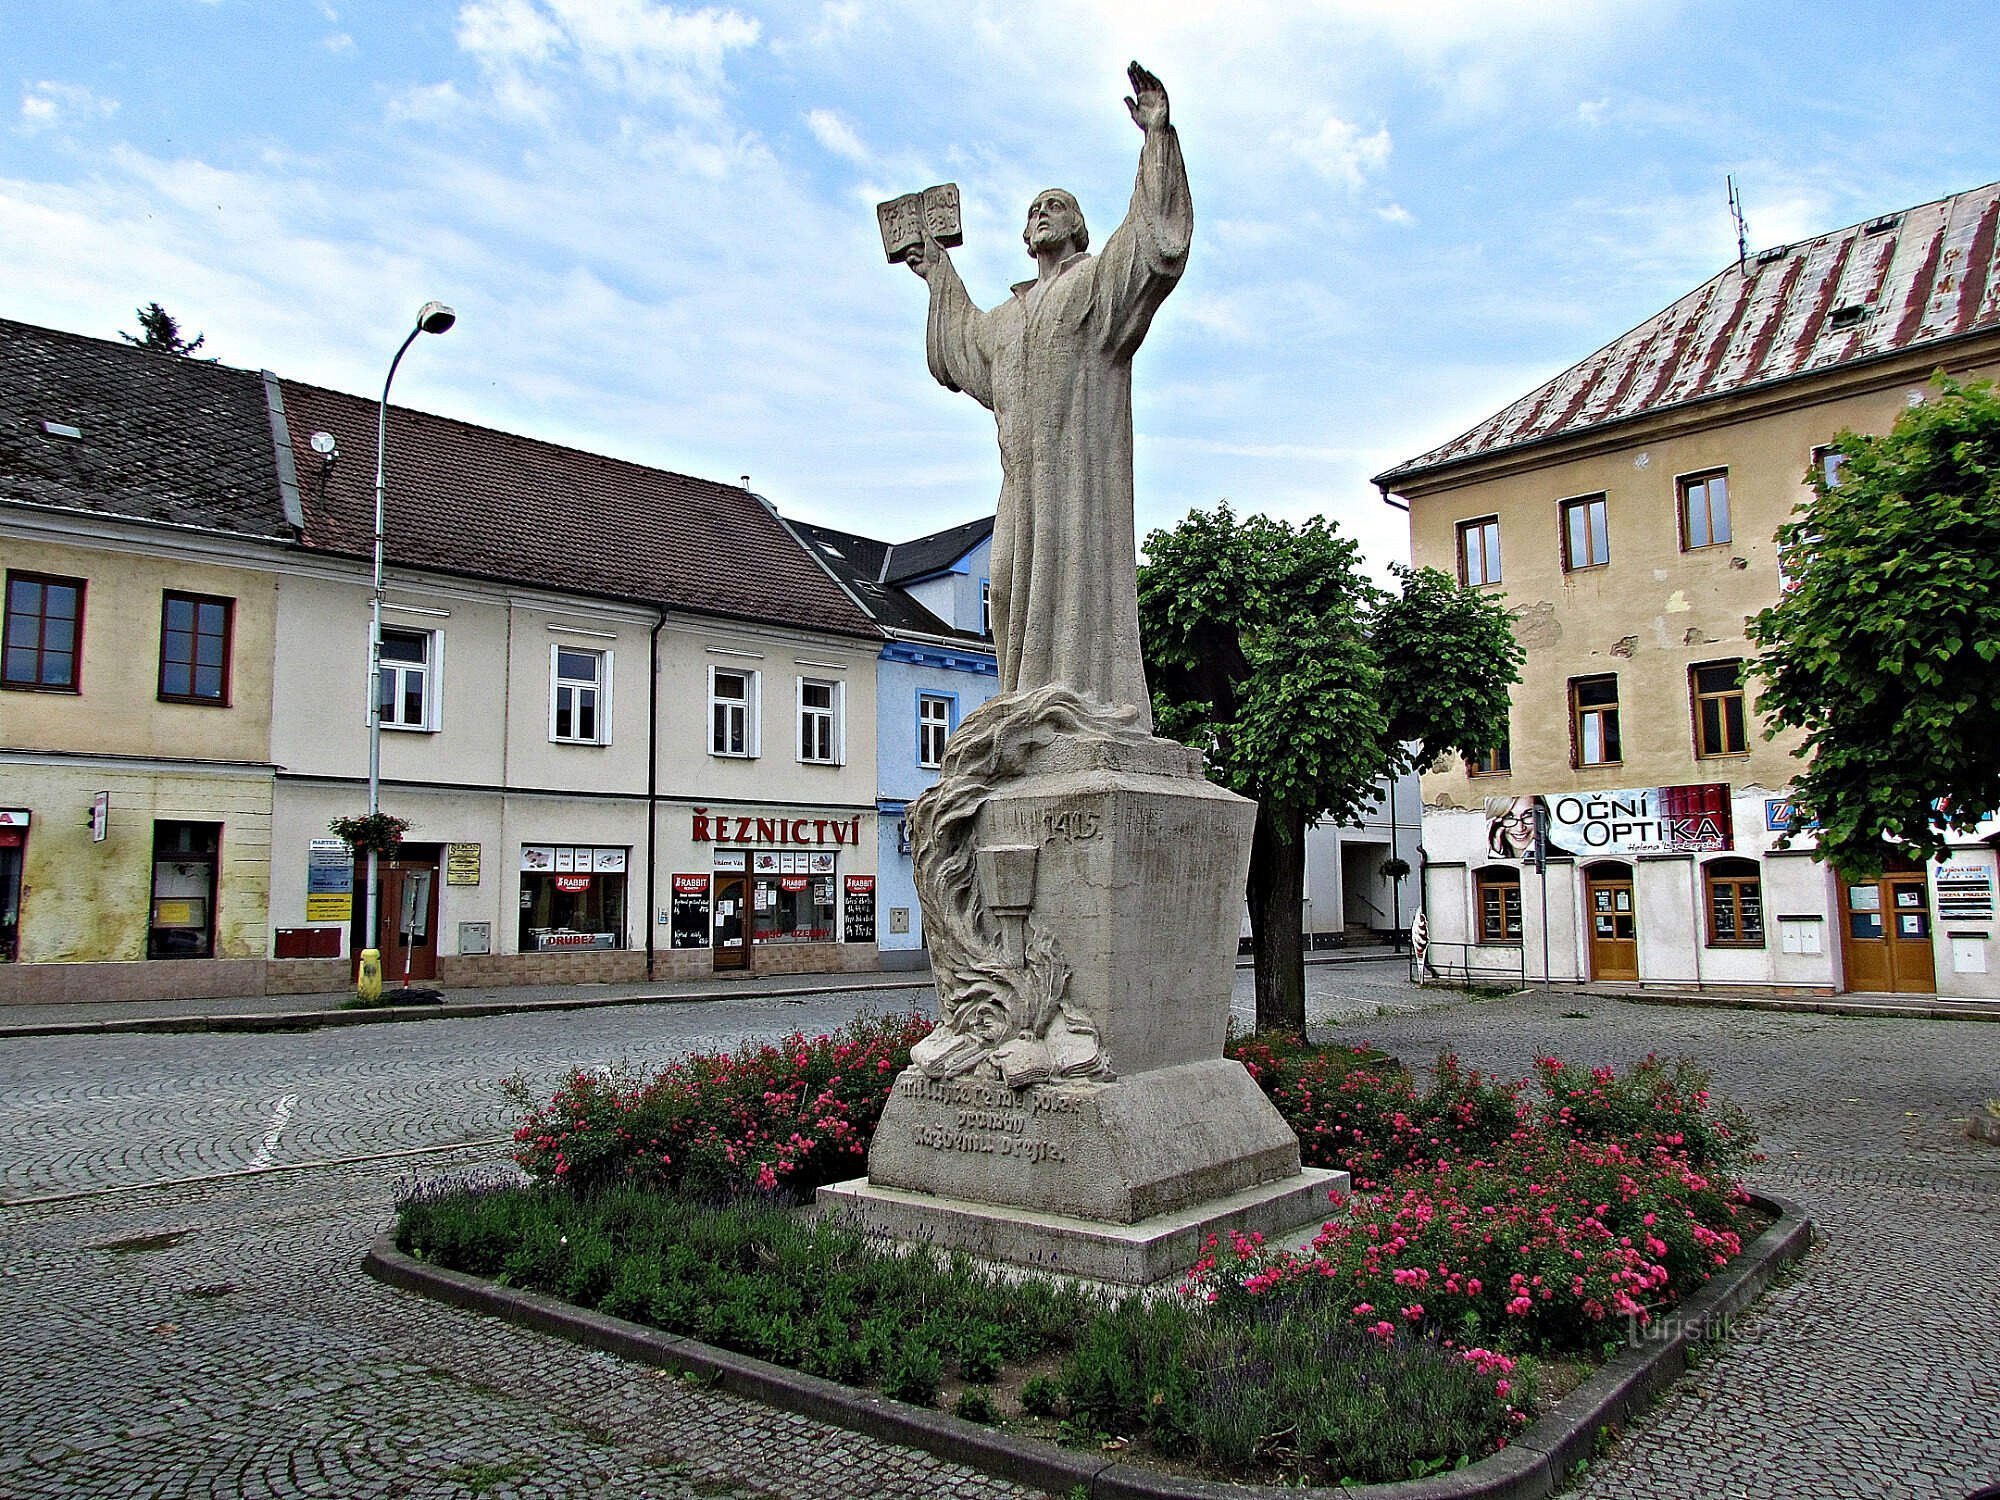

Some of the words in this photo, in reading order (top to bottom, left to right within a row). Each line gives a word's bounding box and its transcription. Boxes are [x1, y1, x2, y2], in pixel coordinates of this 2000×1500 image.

[1556, 791, 1648, 825] OČNÍ
[692, 807, 861, 845] ŘEZNICTVÍ
[1583, 818, 1722, 847] OPTIKA
[563, 878, 590, 888] RABBIT
[681, 878, 707, 888] RABBIT
[786, 879, 807, 887] RABBIT
[851, 879, 873, 888] RABBIT
